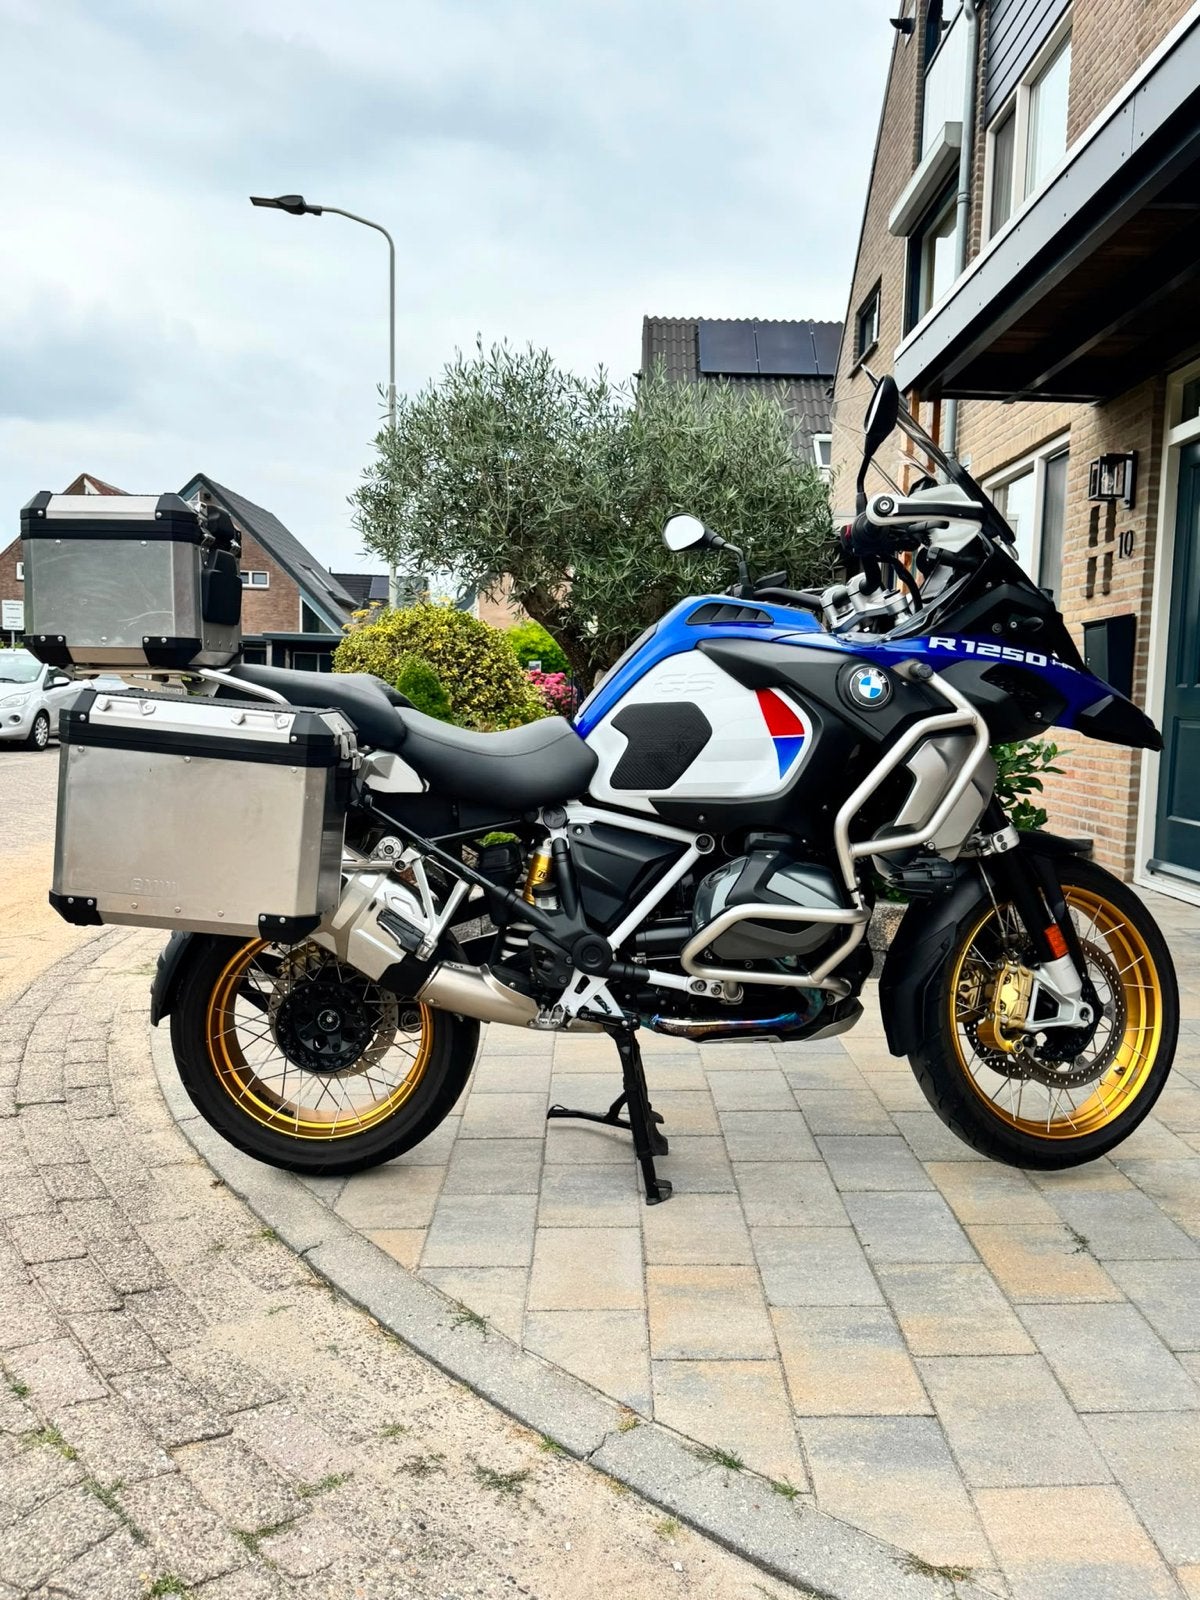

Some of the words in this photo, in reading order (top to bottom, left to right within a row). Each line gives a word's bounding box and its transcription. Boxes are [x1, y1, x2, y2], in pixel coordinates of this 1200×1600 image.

[1119, 530, 1134, 559] 10
[928, 636, 957, 651] R
[961, 640, 1048, 667] 1250
[654, 672, 719, 694] GS
[856, 669, 888, 684] BMW
